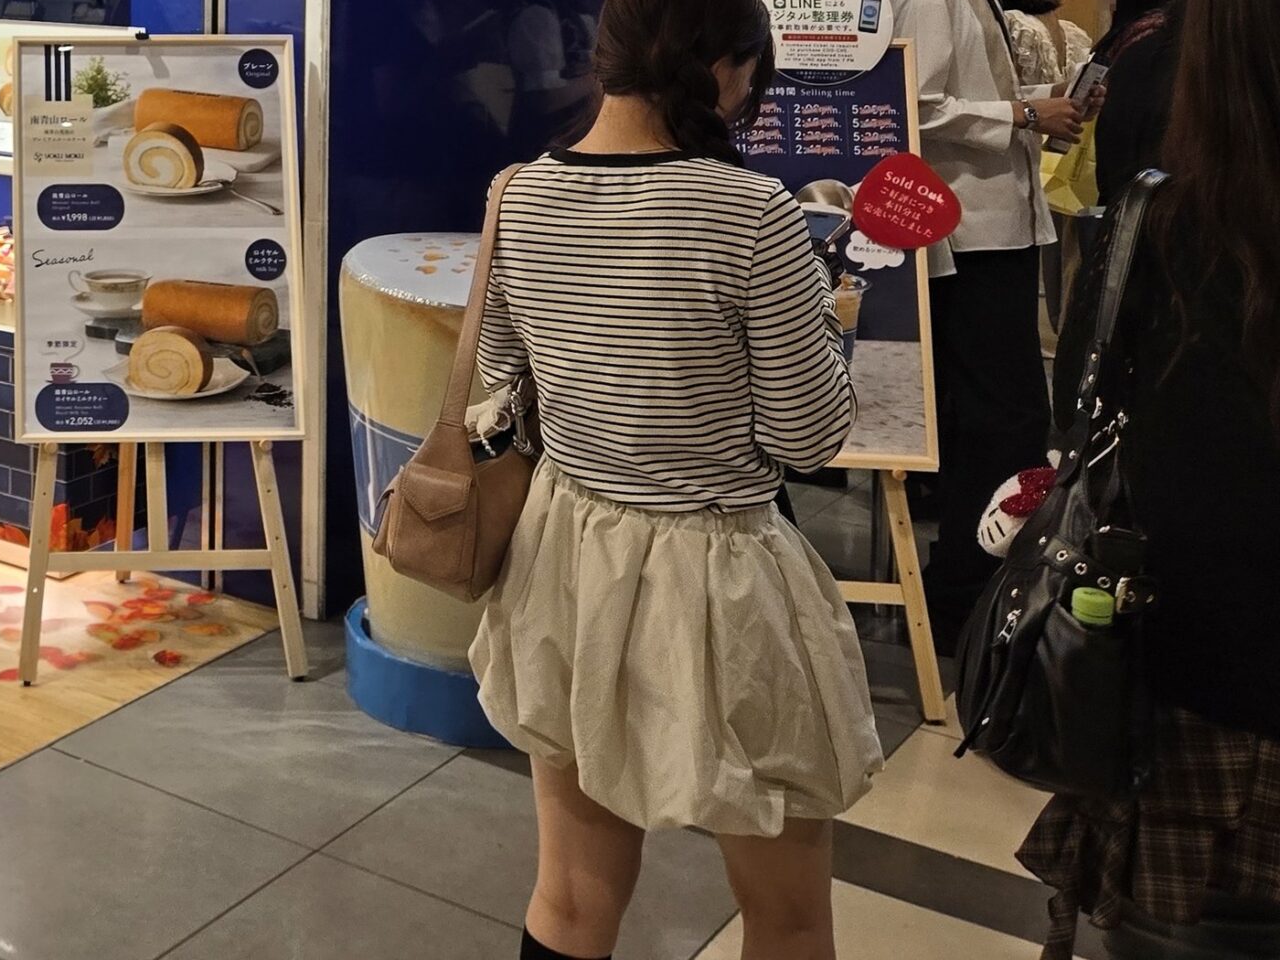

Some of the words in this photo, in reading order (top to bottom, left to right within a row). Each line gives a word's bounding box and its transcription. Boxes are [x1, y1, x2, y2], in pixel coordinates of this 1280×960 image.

[790, 0, 822, 9] LINE
[769, 10, 854, 23] ジタル整理券
[243, 62, 273, 70] プレーン
[800, 88, 832, 97] Selling
[884, 171, 914, 190] Sold
[61, 213, 88, 222] ¥1,998
[863, 202, 933, 238] 完売いたしました
[32, 248, 94, 269] Seasonal
[65, 417, 94, 426] ¥2,052
